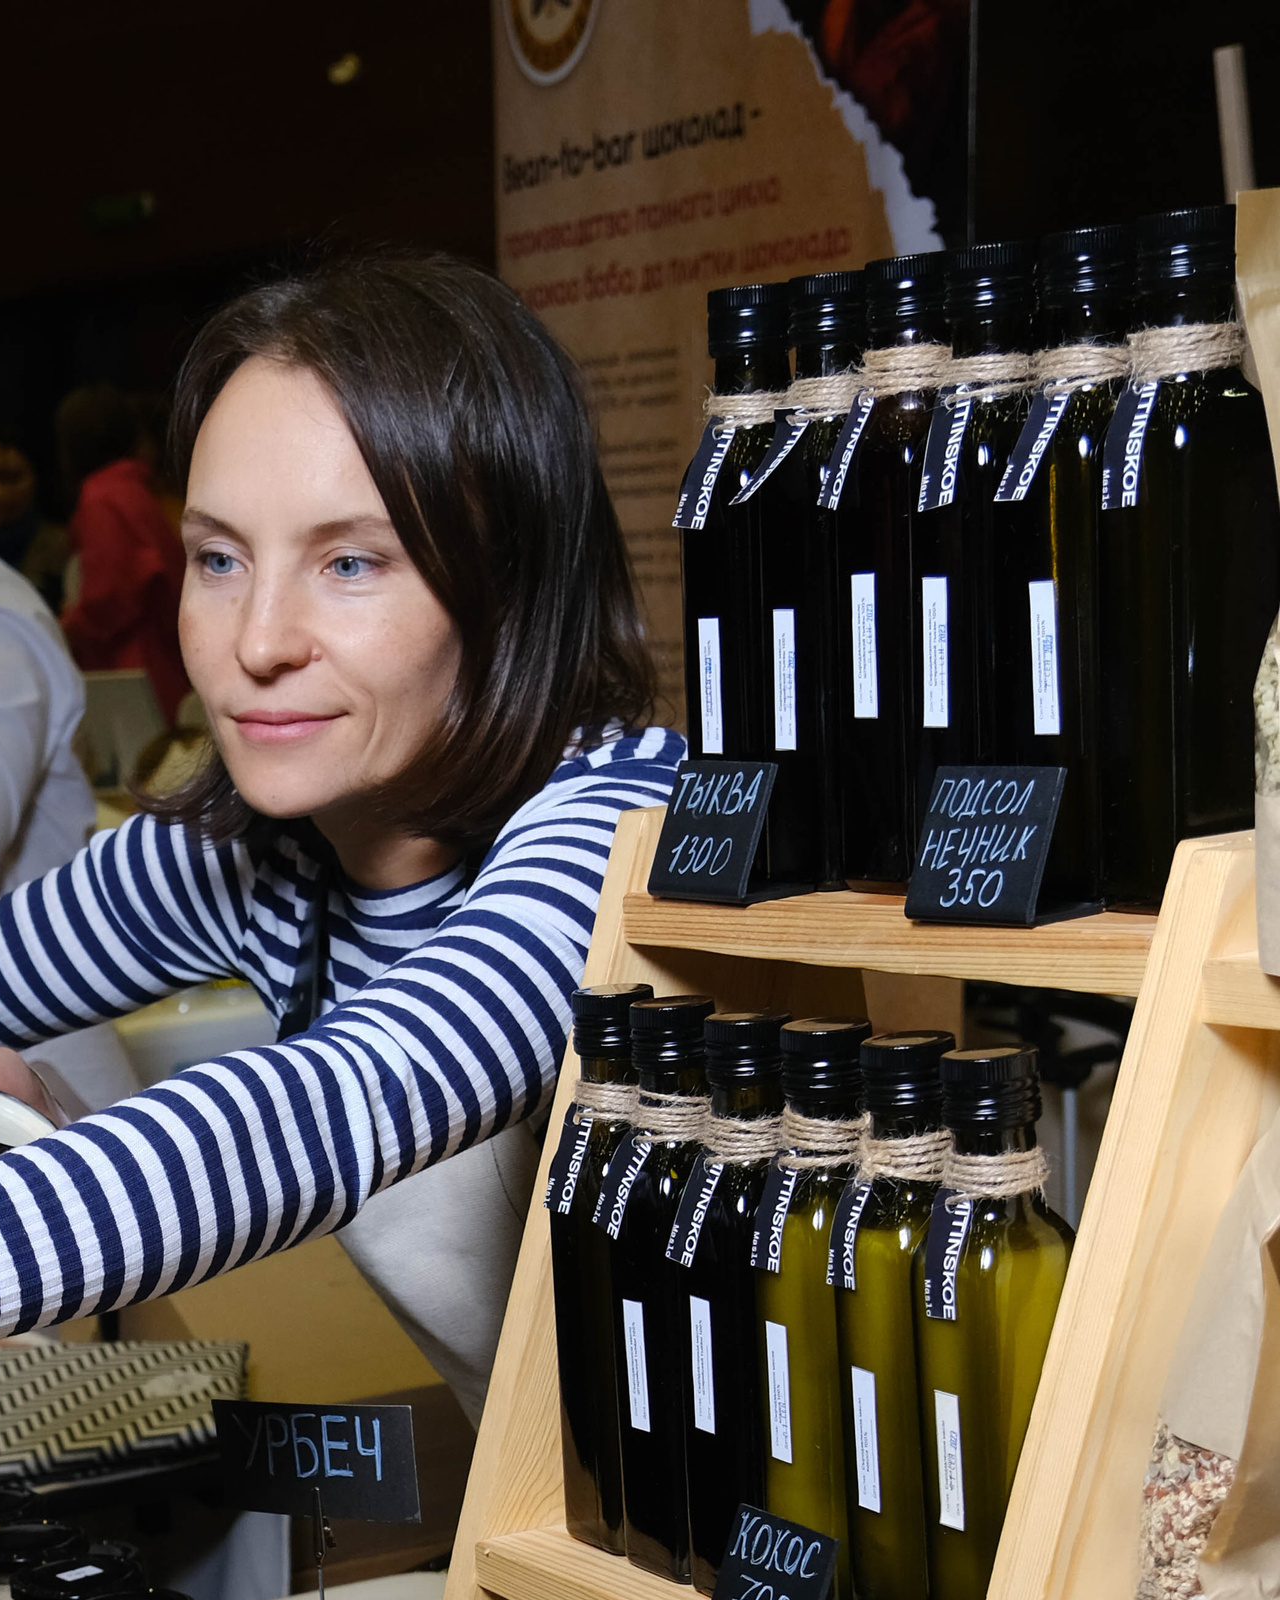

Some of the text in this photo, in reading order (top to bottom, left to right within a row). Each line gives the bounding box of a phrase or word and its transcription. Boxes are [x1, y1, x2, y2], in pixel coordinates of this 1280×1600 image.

[643, 103, 745, 158] шоколад
[938, 624, 946, 643] 2023
[672, 770, 764, 816] ТЫКВА
[930, 778, 1037, 822] ПОДСОЛ
[668, 834, 734, 876] 1300
[920, 824, 1038, 871] НЕЧНИК
[939, 868, 1004, 908] 350
[232, 1412, 383, 1481] УРБЕЧ
[730, 1511, 821, 1579] КОКОС
